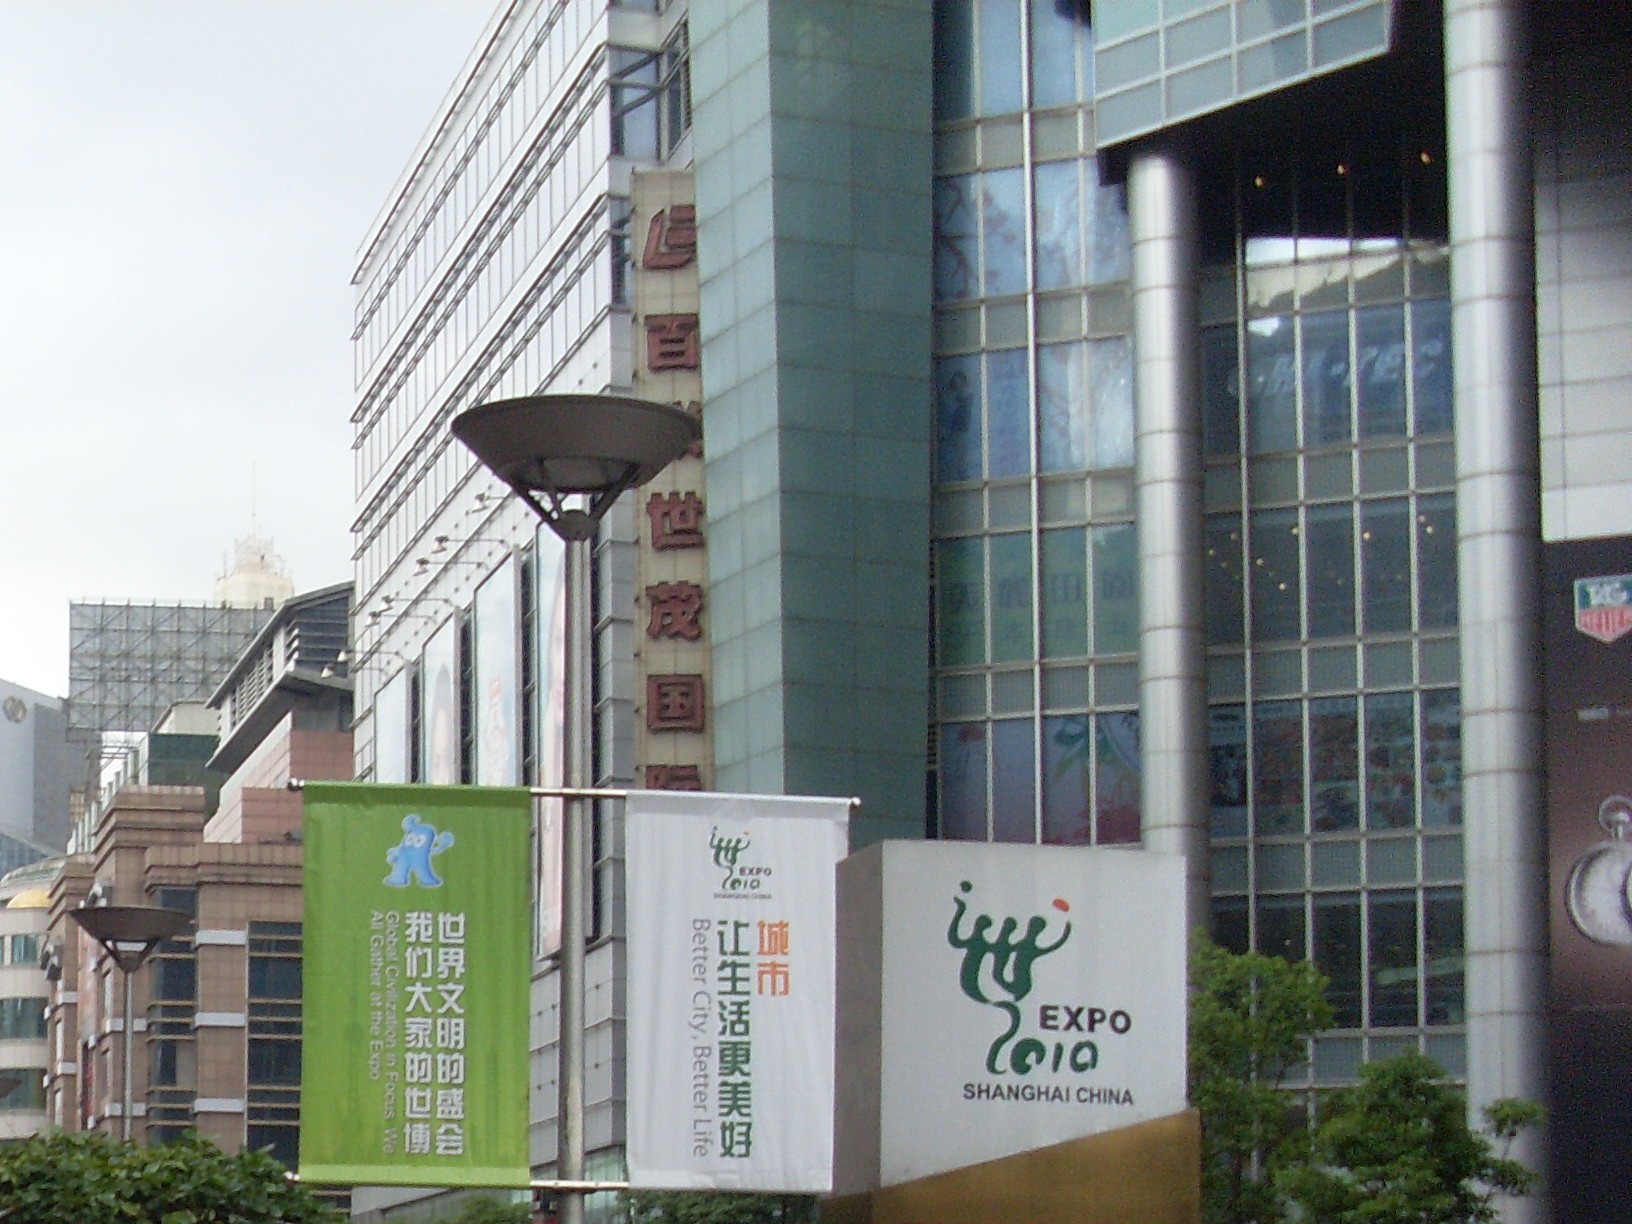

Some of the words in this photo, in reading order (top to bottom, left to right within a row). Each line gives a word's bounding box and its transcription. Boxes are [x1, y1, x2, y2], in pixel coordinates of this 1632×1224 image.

[644, 313, 705, 790] 百世茂国
[739, 866, 773, 877] EXPO
[371, 911, 384, 930] All
[385, 911, 400, 960] Global
[370, 935, 384, 987] Gather
[692, 919, 711, 985] Better
[756, 918, 790, 997] 城市
[370, 1012, 383, 1036] the
[371, 991, 382, 1008] at
[385, 965, 400, 1048] Civilization
[688, 990, 712, 1040] City,
[1039, 1004, 1132, 1034] EXPO
[404, 911, 434, 1155] 我们大家的世博
[436, 911, 466, 1156] 世界文明的盛会
[717, 919, 753, 1159] 让生活更美好
[368, 1039, 383, 1081] Expo
[385, 1053, 398, 1068] in
[693, 1045, 712, 1111] Better
[963, 1082, 1070, 1102] SHANGHAI
[1076, 1086, 1134, 1106] CHINA
[383, 1127, 397, 1154] We
[693, 1118, 713, 1157] Life
